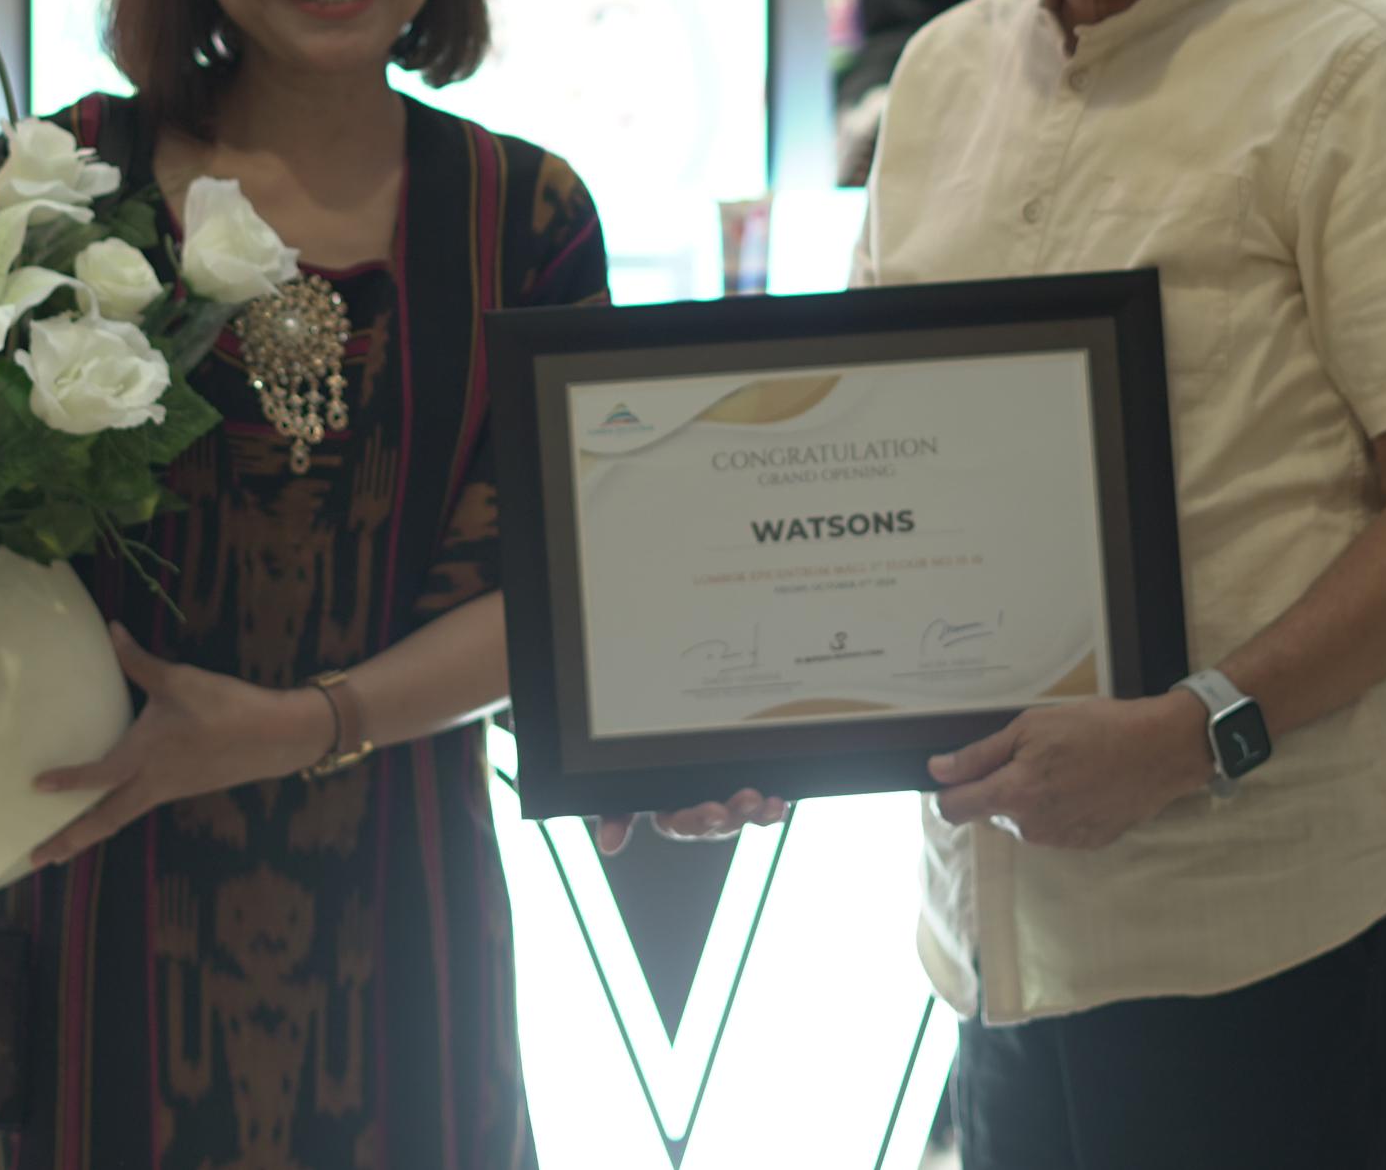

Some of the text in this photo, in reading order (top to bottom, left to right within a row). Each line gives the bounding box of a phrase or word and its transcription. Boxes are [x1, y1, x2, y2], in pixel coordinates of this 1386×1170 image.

[711, 436, 939, 472] CONGRATULATION
[758, 463, 896, 487] GRAND OPENING
[750, 509, 917, 544] WATSONS
